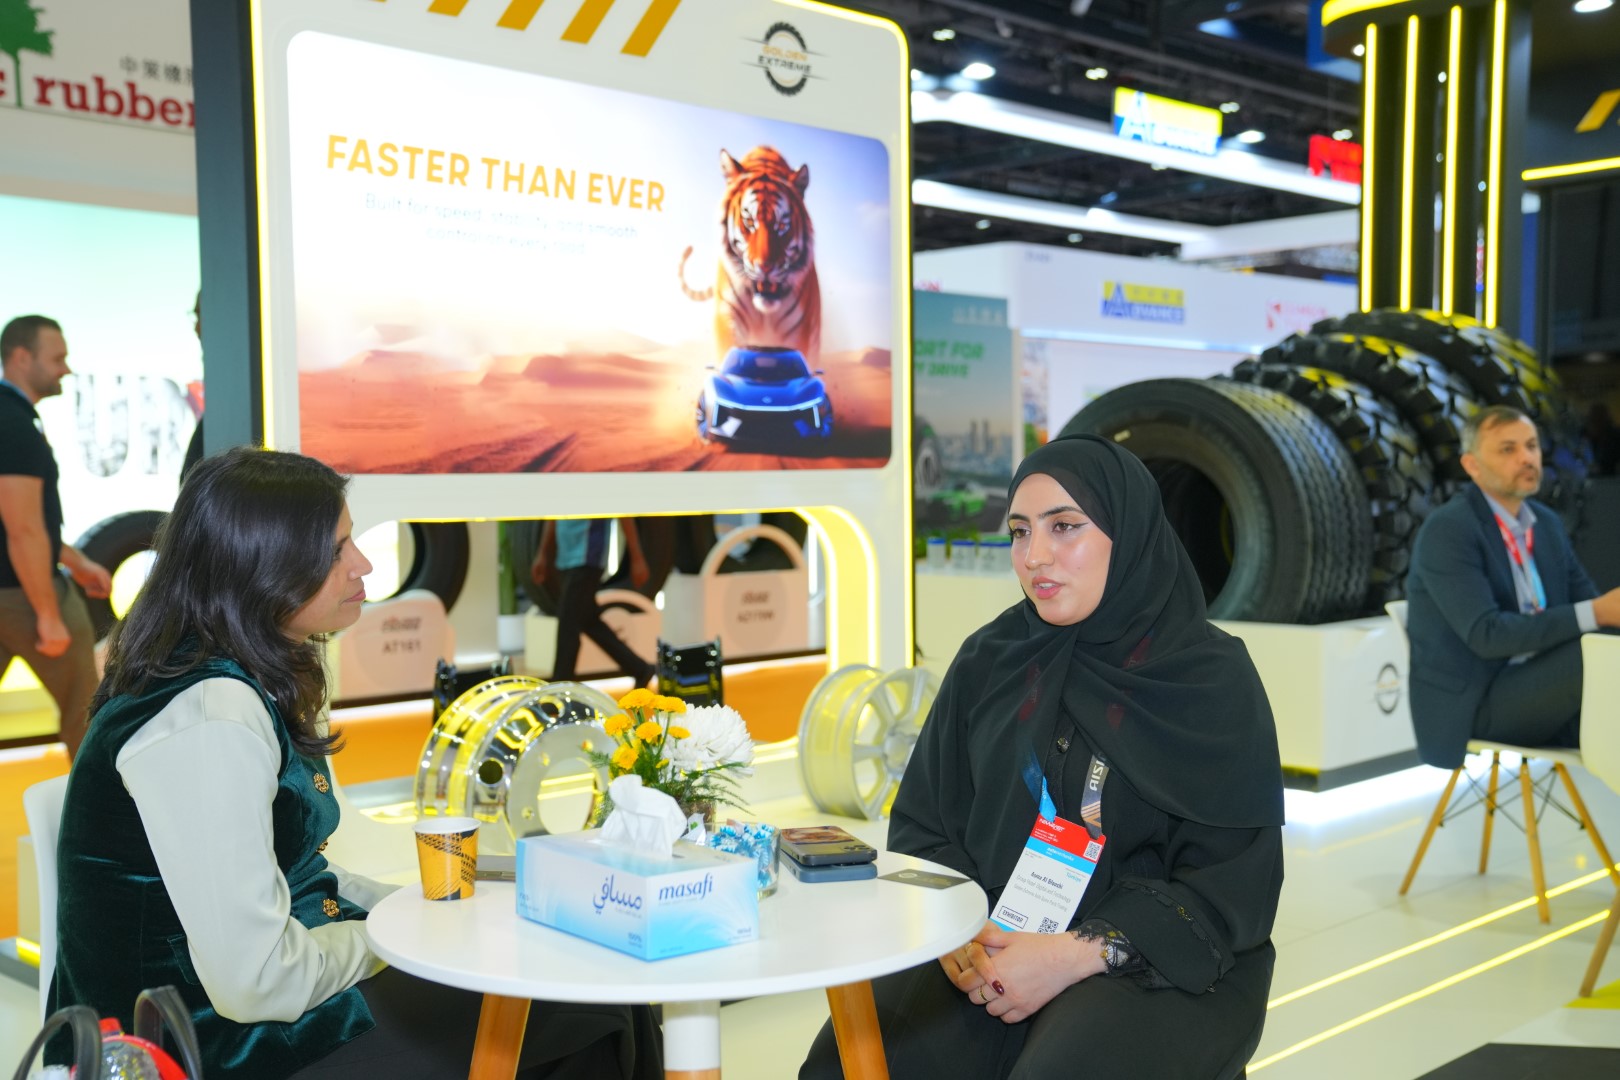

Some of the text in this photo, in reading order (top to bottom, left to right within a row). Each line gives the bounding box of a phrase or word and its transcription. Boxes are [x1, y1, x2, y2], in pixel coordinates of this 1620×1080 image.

[758, 56, 810, 73] EXTREME
[327, 134, 665, 212] FASTER THAN EVER
[366, 193, 401, 210] Built
[408, 198, 428, 214] for
[588, 221, 637, 238] smooth
[1089, 758, 1106, 792] AISI
[593, 874, 642, 915] مسافي
[659, 872, 713, 901] masafi
[1002, 909, 1023, 923] EXHIBITOR
